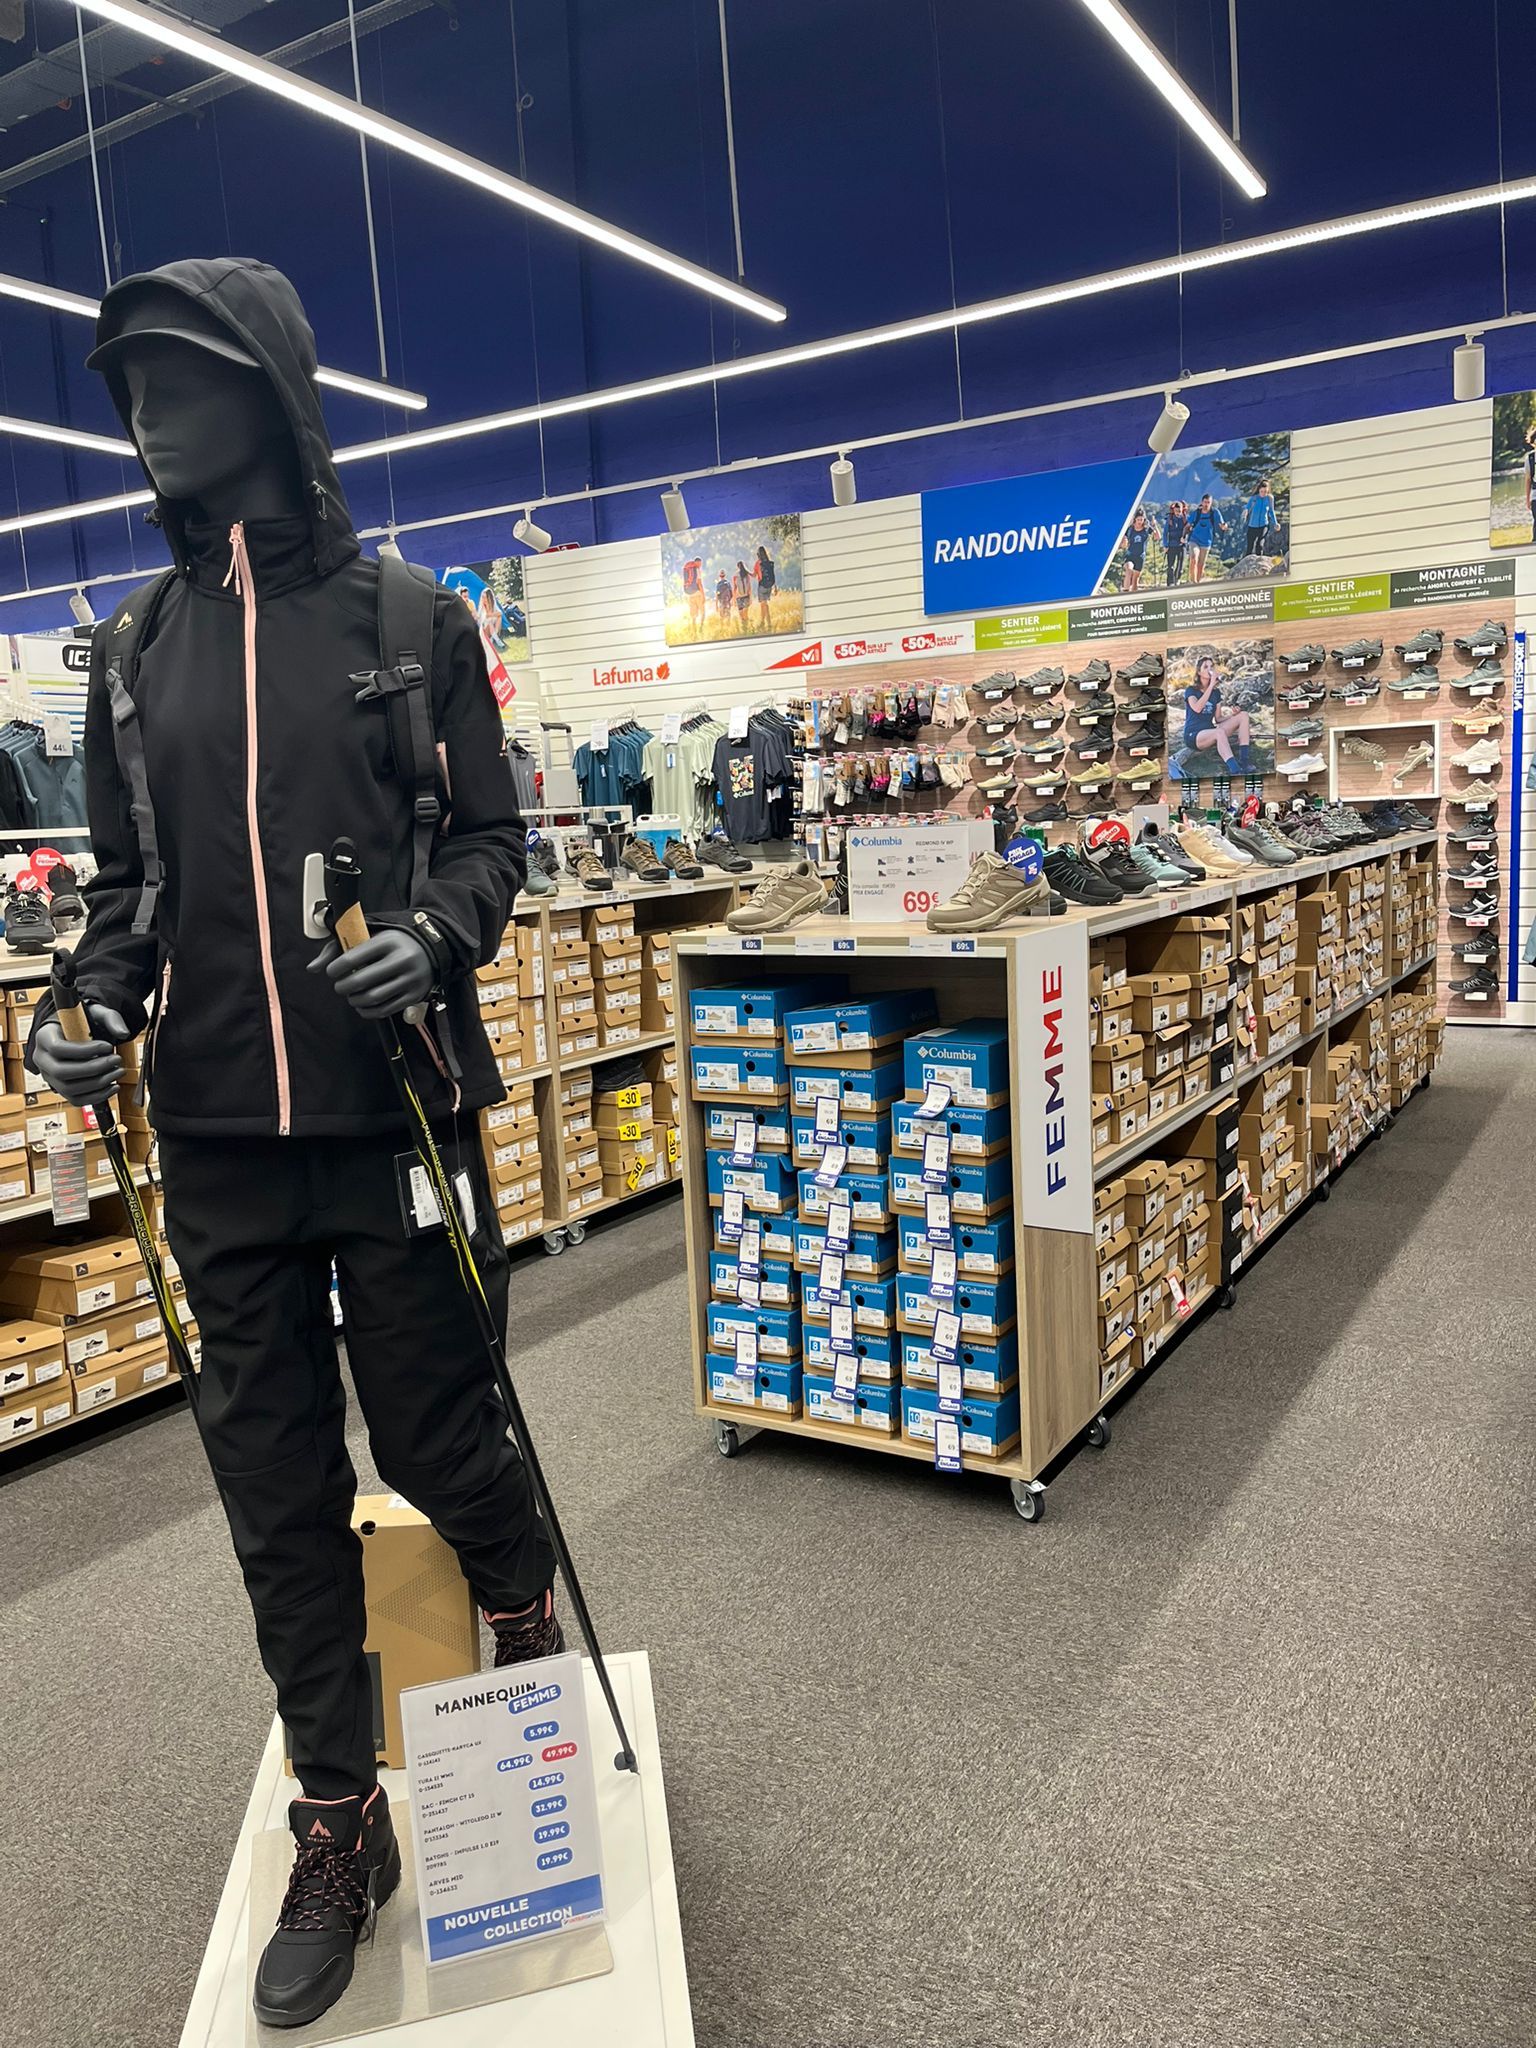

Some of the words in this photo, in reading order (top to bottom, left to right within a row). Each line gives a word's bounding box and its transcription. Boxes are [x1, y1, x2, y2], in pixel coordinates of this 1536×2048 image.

[934, 514, 1091, 564] RANDONNÉE
[1419, 565, 1486, 582] MONTAGNE
[1451, 578, 1477, 587] CONFORT
[1483, 574, 1513, 583] STABILITÉ
[1307, 580, 1355, 595] SENTIER
[1171, 598, 1210, 611] GRANDE
[1211, 590, 1271, 607] RANDONNÉE
[1313, 594, 1349, 602] POLYVALENCE
[1090, 604, 1144, 619] MONTAGNE
[1001, 615, 1040, 629] SENTIER
[903, 636, 935, 649] -50%
[836, 643, 866, 656] -50%
[1514, 640, 1526, 699] INTERSPORT
[593, 665, 653, 687] Lafuma
[861, 836, 902, 847] Columbia
[698, 1011, 705, 1019] 9
[795, 1030, 801, 1038] 7
[929, 1048, 977, 1061] Columbia
[699, 1068, 705, 1076] 9
[845, 1071, 872, 1079] Columbia
[926, 1069, 932, 1078] 6
[1042, 966, 1067, 1196] FEMME
[798, 1082, 805, 1091] 8
[714, 1114, 720, 1123] 7
[953, 1112, 983, 1121] Columbia
[848, 1124, 874, 1132] Columbia
[902, 1123, 908, 1132] 7
[801, 1134, 807, 1142] 7
[953, 1167, 983, 1176] Columbia
[725, 1175, 732, 1184] 6
[897, 1178, 904, 1187] 9
[854, 1181, 880, 1189] Columbia
[808, 1190, 814, 1199] 8
[965, 1225, 994, 1235] Columbia
[801, 1239, 808, 1248] 8
[909, 1238, 915, 1247] 9
[764, 1262, 789, 1272] Columbia
[719, 1269, 725, 1277] 8
[857, 1285, 883, 1294] Columbia
[965, 1286, 994, 1296] Columbia
[809, 1292, 815, 1300] 8
[909, 1299, 915, 1308] 9
[763, 1316, 788, 1325] Columbia
[716, 1323, 723, 1332] 8
[860, 1336, 887, 1345] Columbia
[811, 1341, 818, 1351] 8
[910, 1352, 916, 1361] 9
[763, 1367, 788, 1376] Columbia
[715, 1378, 723, 1387] 10
[813, 1394, 819, 1403] 8
[910, 1411, 920, 1423] 10
[435, 1682, 537, 1716] MANNEQUIN
[513, 1686, 559, 1712] FEMME
[530, 1725, 553, 1738] 5.99€
[546, 1746, 573, 1758] 49.99€
[500, 1755, 531, 1770] 64.99€
[533, 1773, 562, 1788] 14.99€
[535, 1799, 563, 1813] 32.99€
[538, 1825, 566, 1840] 19.99€
[541, 1852, 568, 1866] 19.99€
[444, 1897, 529, 1932] NOUVELLE
[484, 1905, 573, 1940] COLLECTION
